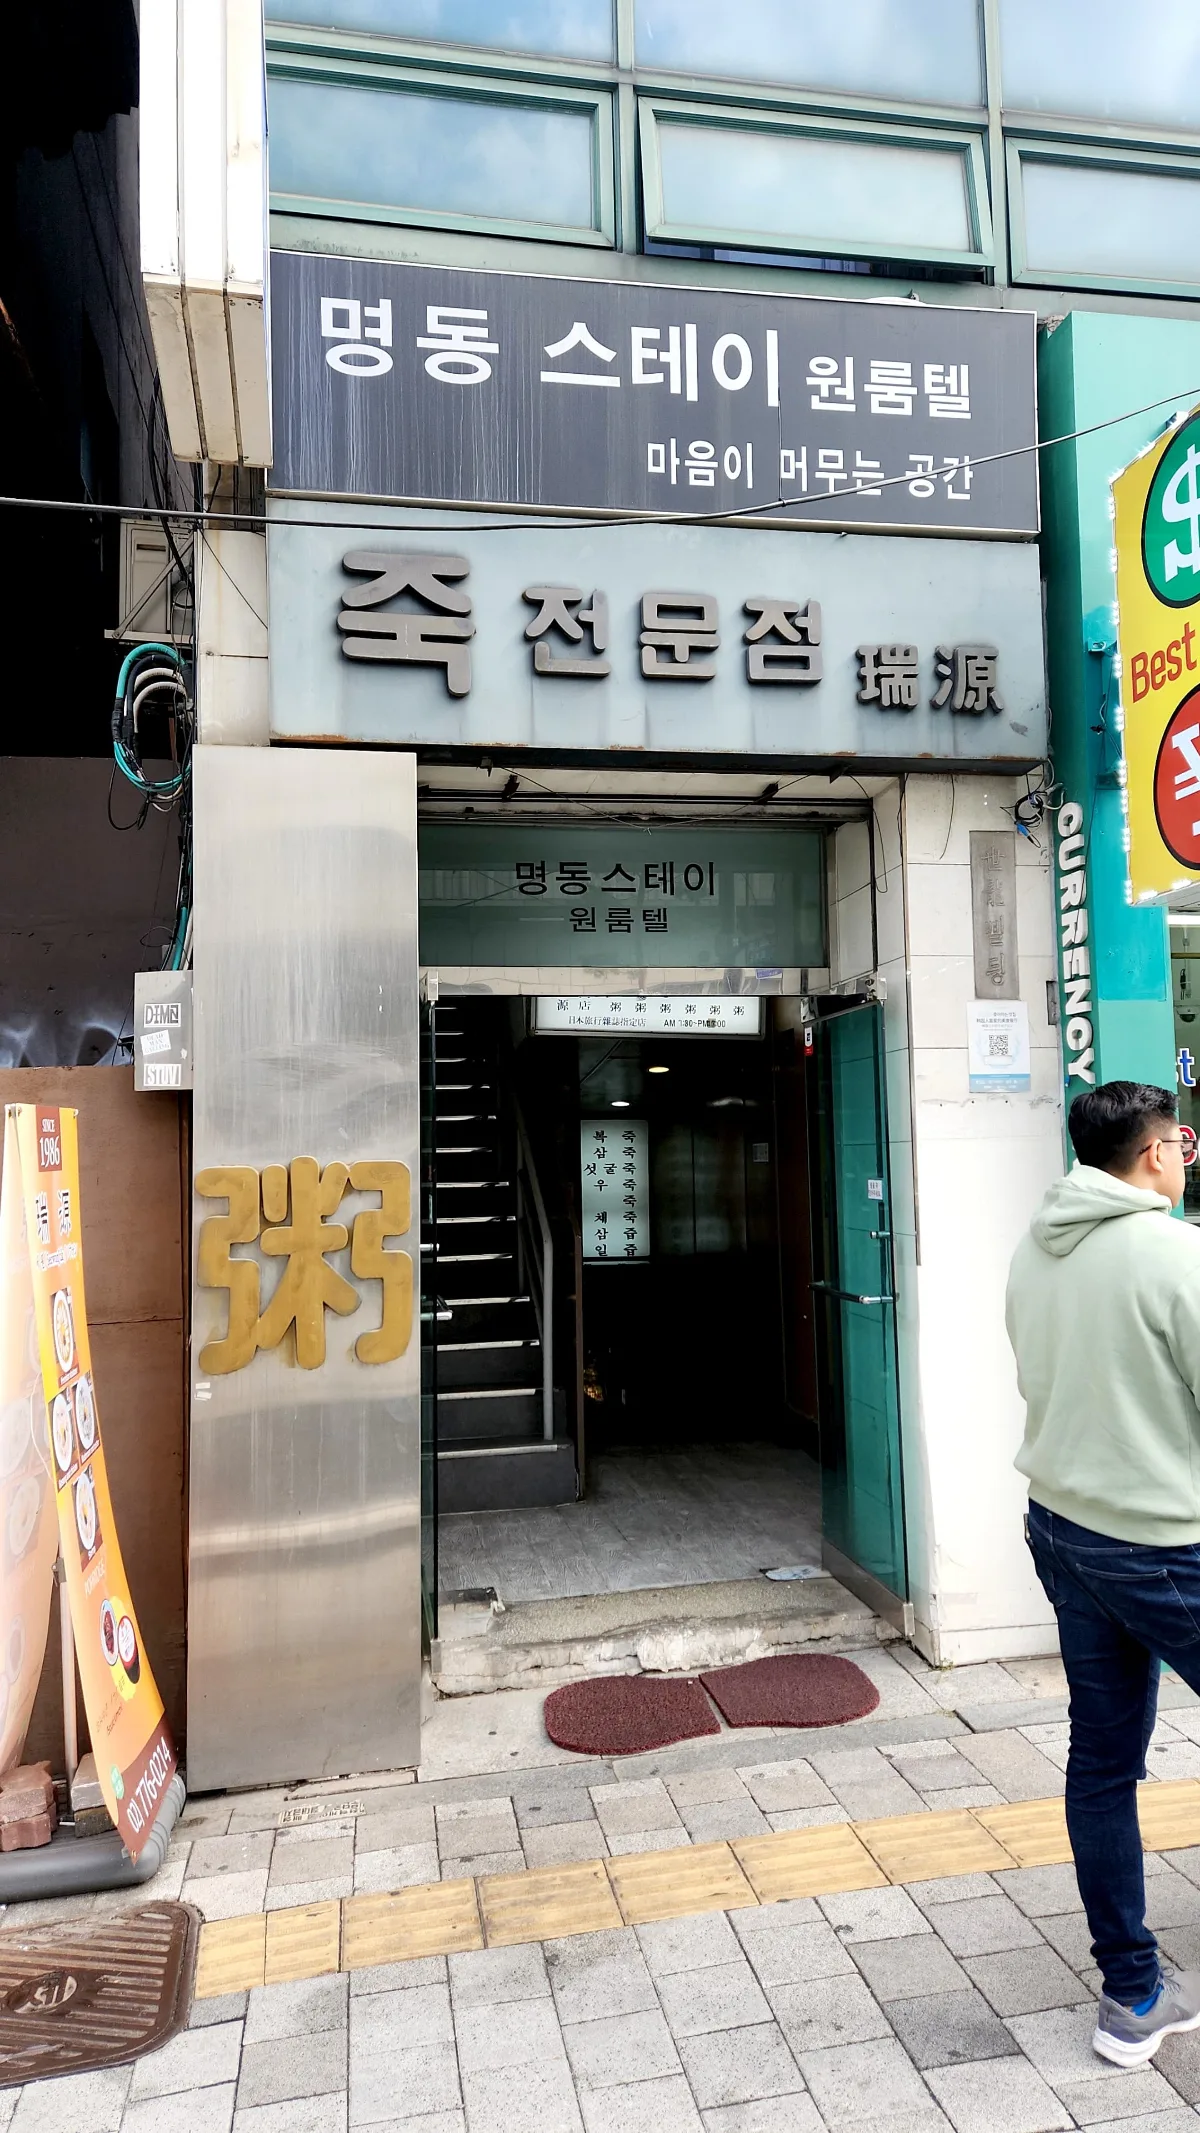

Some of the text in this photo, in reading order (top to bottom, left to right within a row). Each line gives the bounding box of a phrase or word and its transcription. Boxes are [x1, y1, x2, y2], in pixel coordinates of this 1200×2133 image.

[321, 296, 972, 420] 명동 스테이 원룸텔
[647, 437, 975, 501] 마음이 머무는 공간
[336, 550, 1004, 714] 죽 전문점 瑞源
[1131, 621, 1196, 704] Best
[515, 860, 715, 896] 명동스테이
[569, 906, 669, 933] 원룸텔
[1057, 801, 1096, 1085] CURRENCY
[663, 1019, 676, 1028] AM
[42, 1119, 56, 1132] SINCE
[622, 1130, 636, 1143] 죽
[39, 1136, 61, 1168] 1986
[593, 1146, 636, 1159] 삼 죽
[583, 1162, 636, 1176] 섯 굴 죽
[594, 1178, 637, 1192] 우 죽
[623, 1194, 637, 1208] 죽
[594, 1211, 637, 1224] 채 죽
[594, 1227, 609, 1240] 삼
[595, 1243, 608, 1257] 일
[194, 1155, 413, 1376] 粥
[135, 1736, 172, 1818] 776-0214
